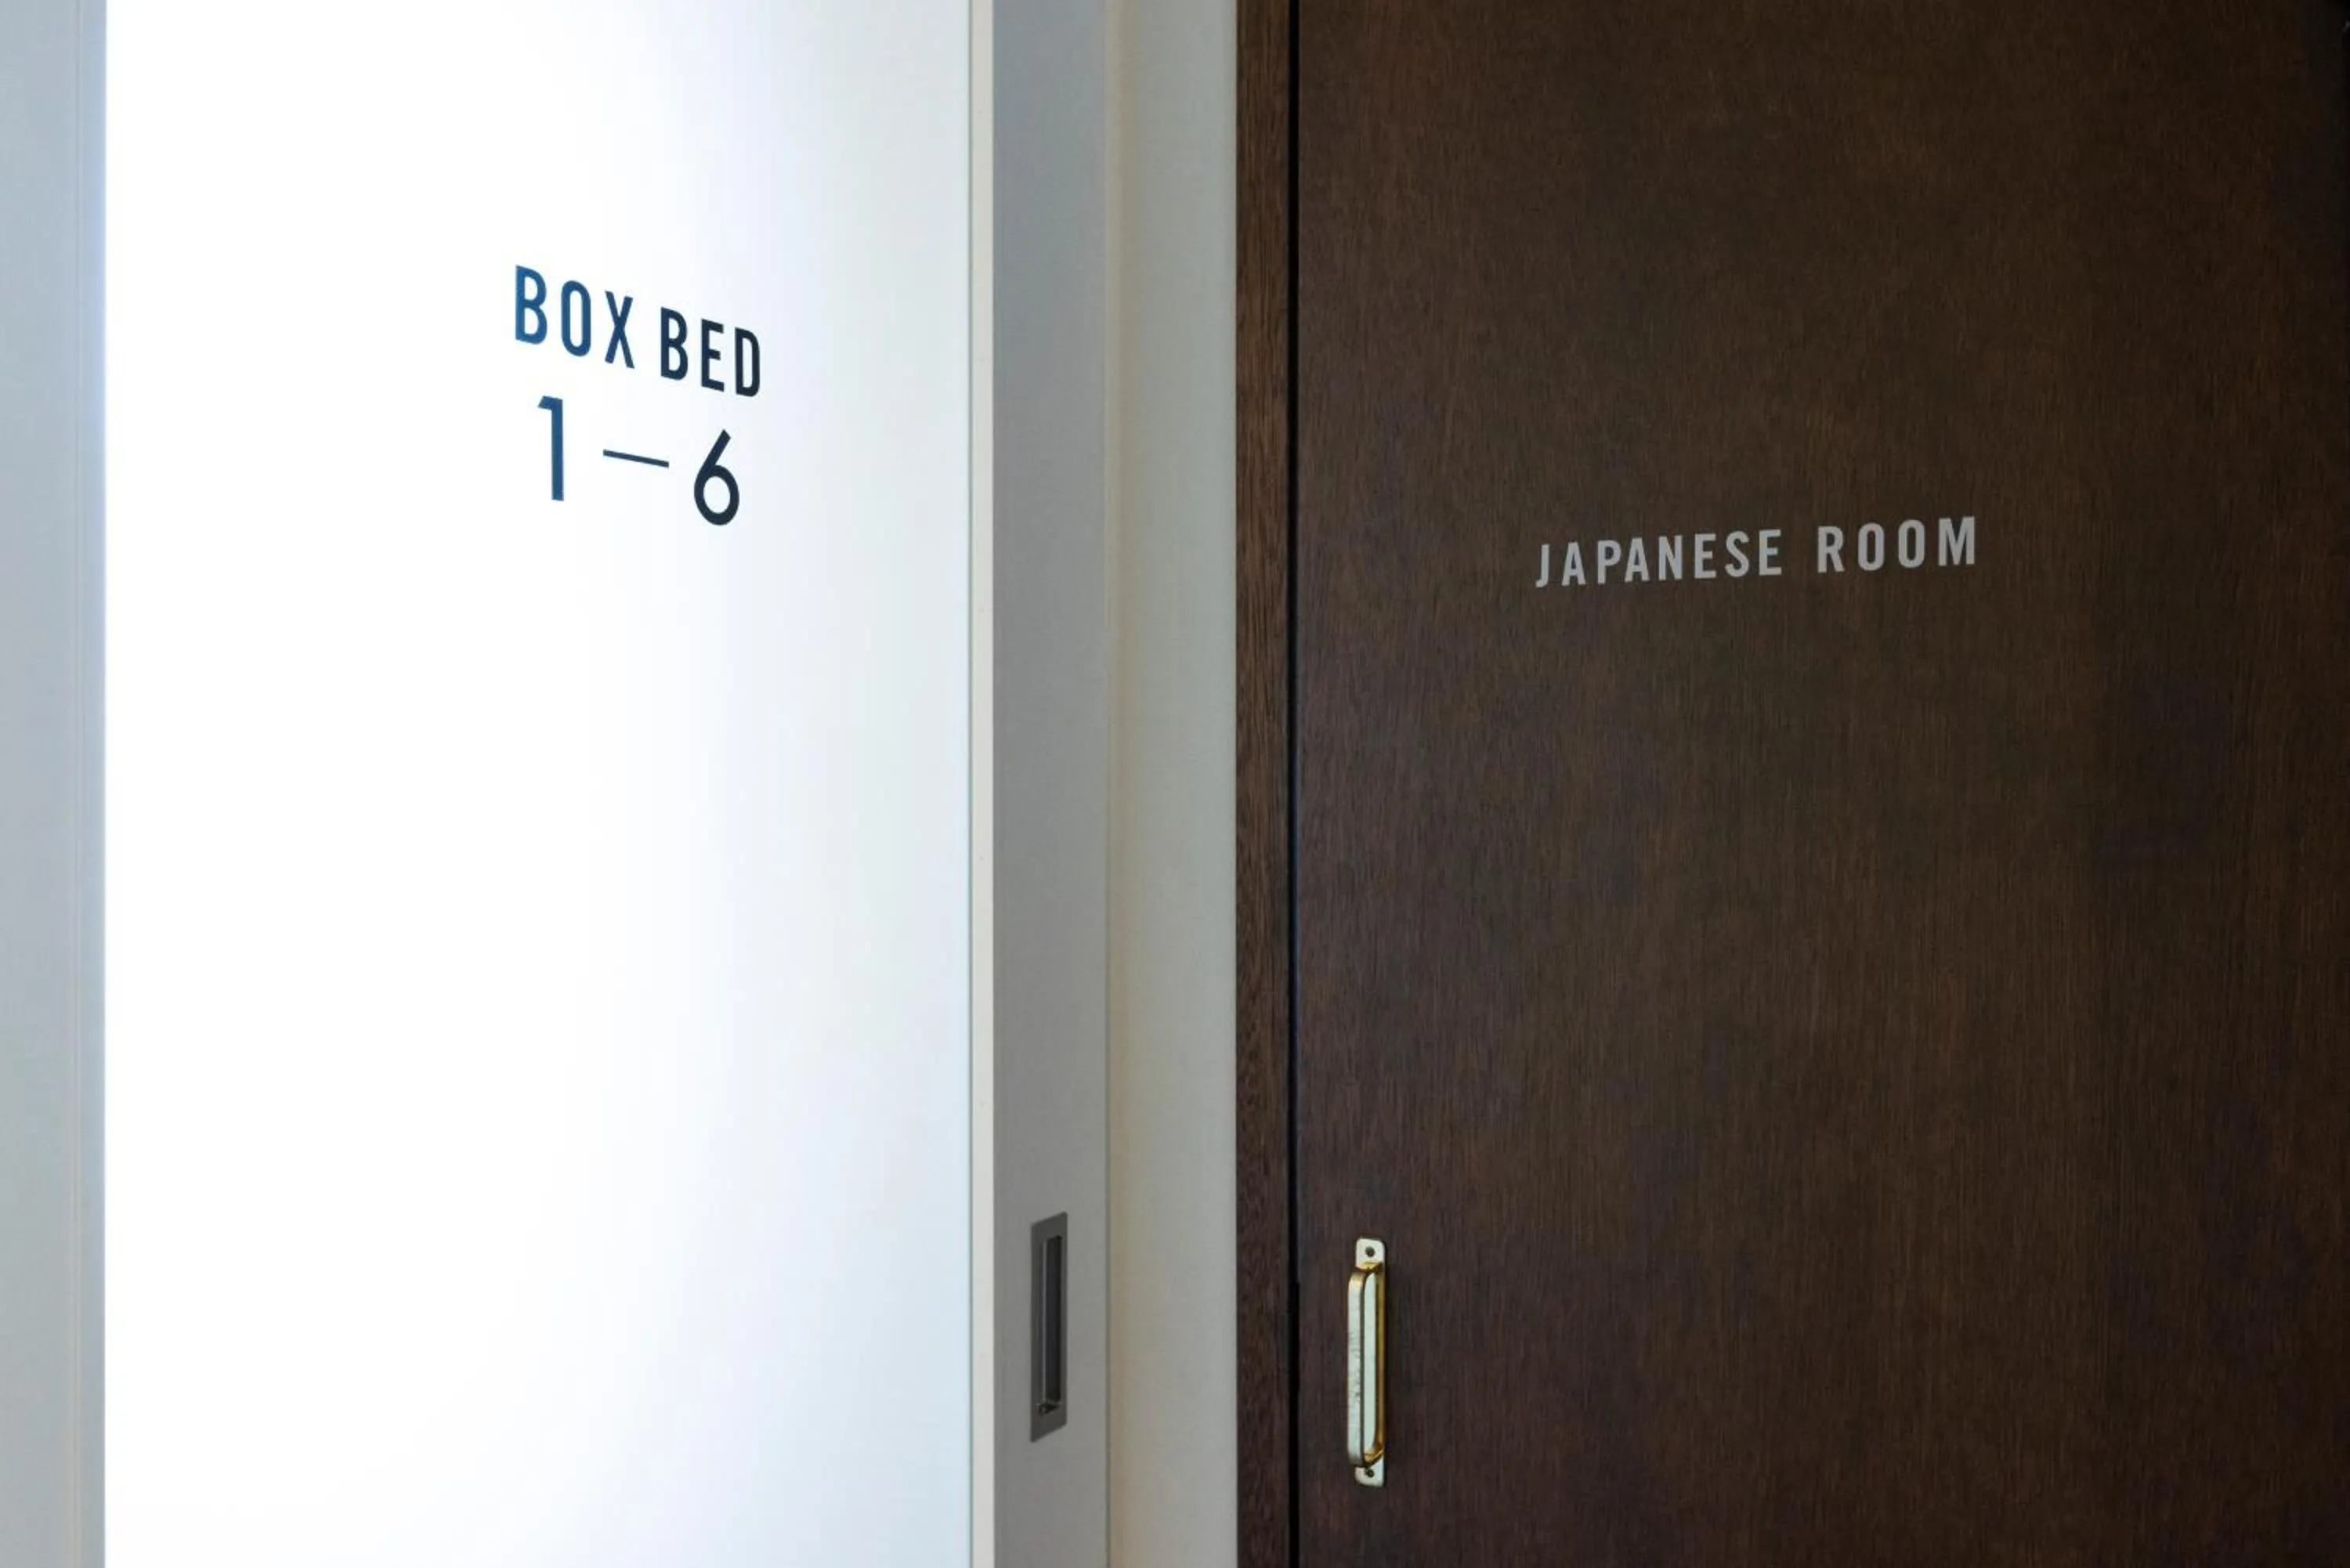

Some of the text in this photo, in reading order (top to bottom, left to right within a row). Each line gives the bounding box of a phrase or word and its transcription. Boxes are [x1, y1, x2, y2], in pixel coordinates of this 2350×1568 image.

[515, 265, 761, 398] BOX BED
[1535, 516, 1976, 588] JAPANESE ROOM
